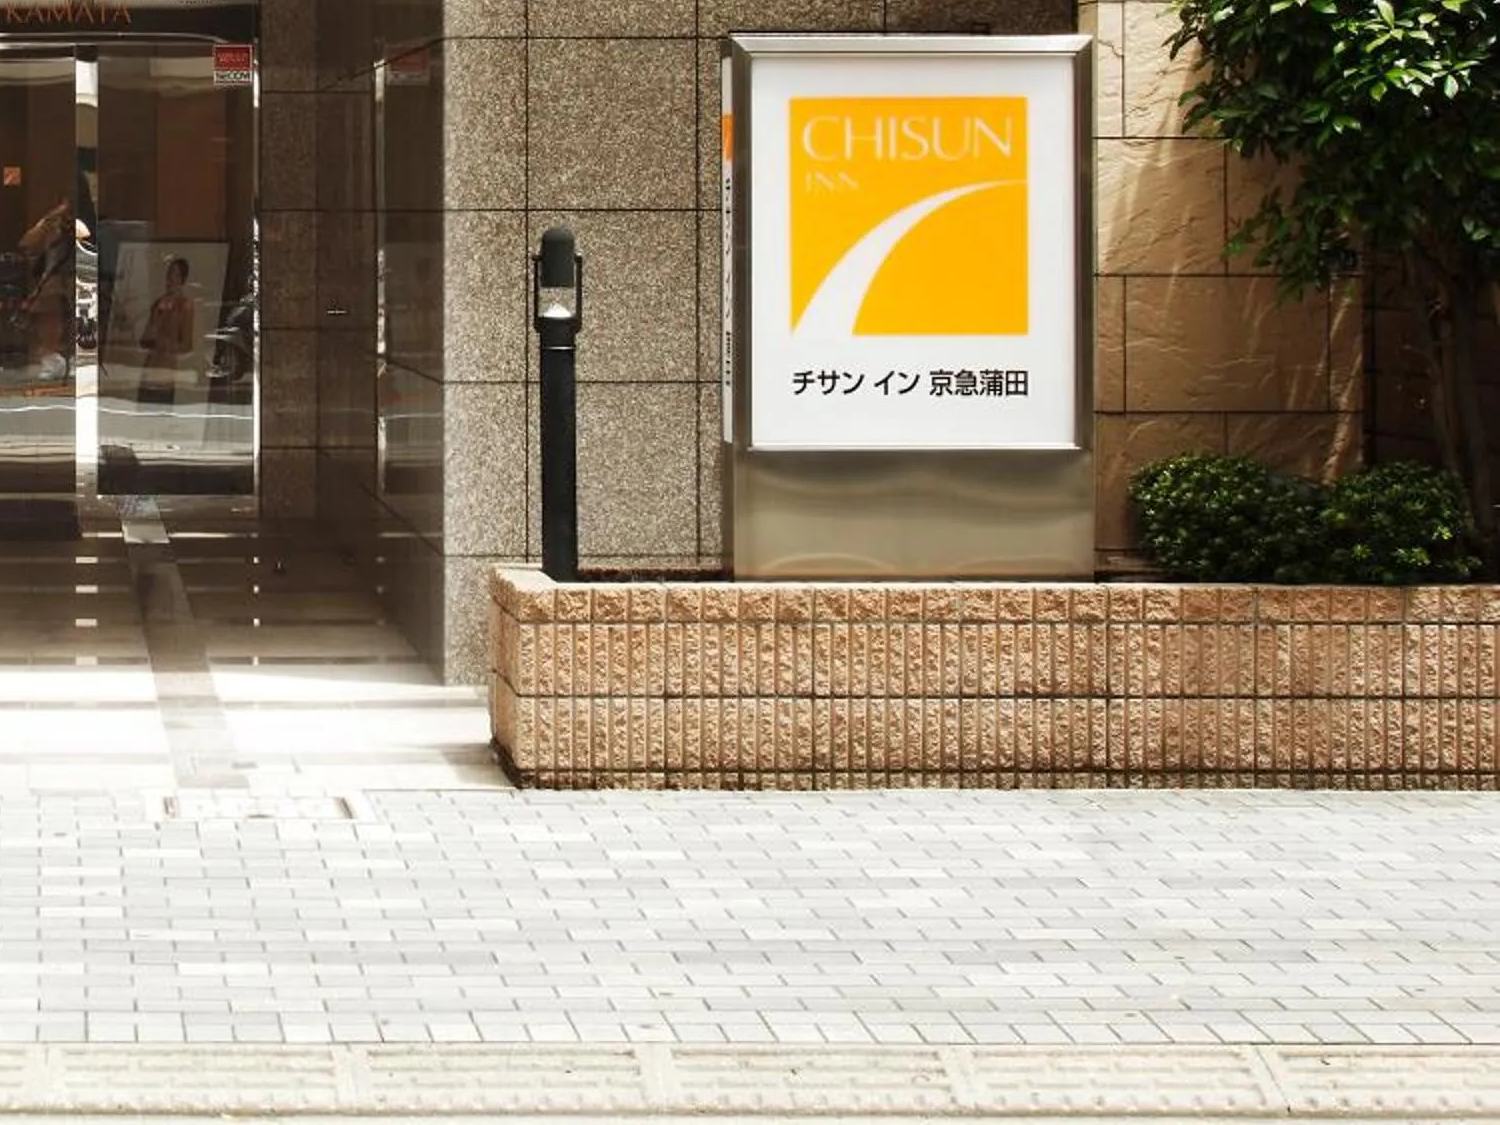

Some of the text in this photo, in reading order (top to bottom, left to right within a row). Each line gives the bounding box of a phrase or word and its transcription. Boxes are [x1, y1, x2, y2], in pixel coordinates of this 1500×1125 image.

[5, 0, 132, 24] KAMATA
[802, 115, 1014, 162] CHISUN
[805, 171, 860, 193] INN
[793, 369, 1030, 397] チサン イン 京急蒲田
